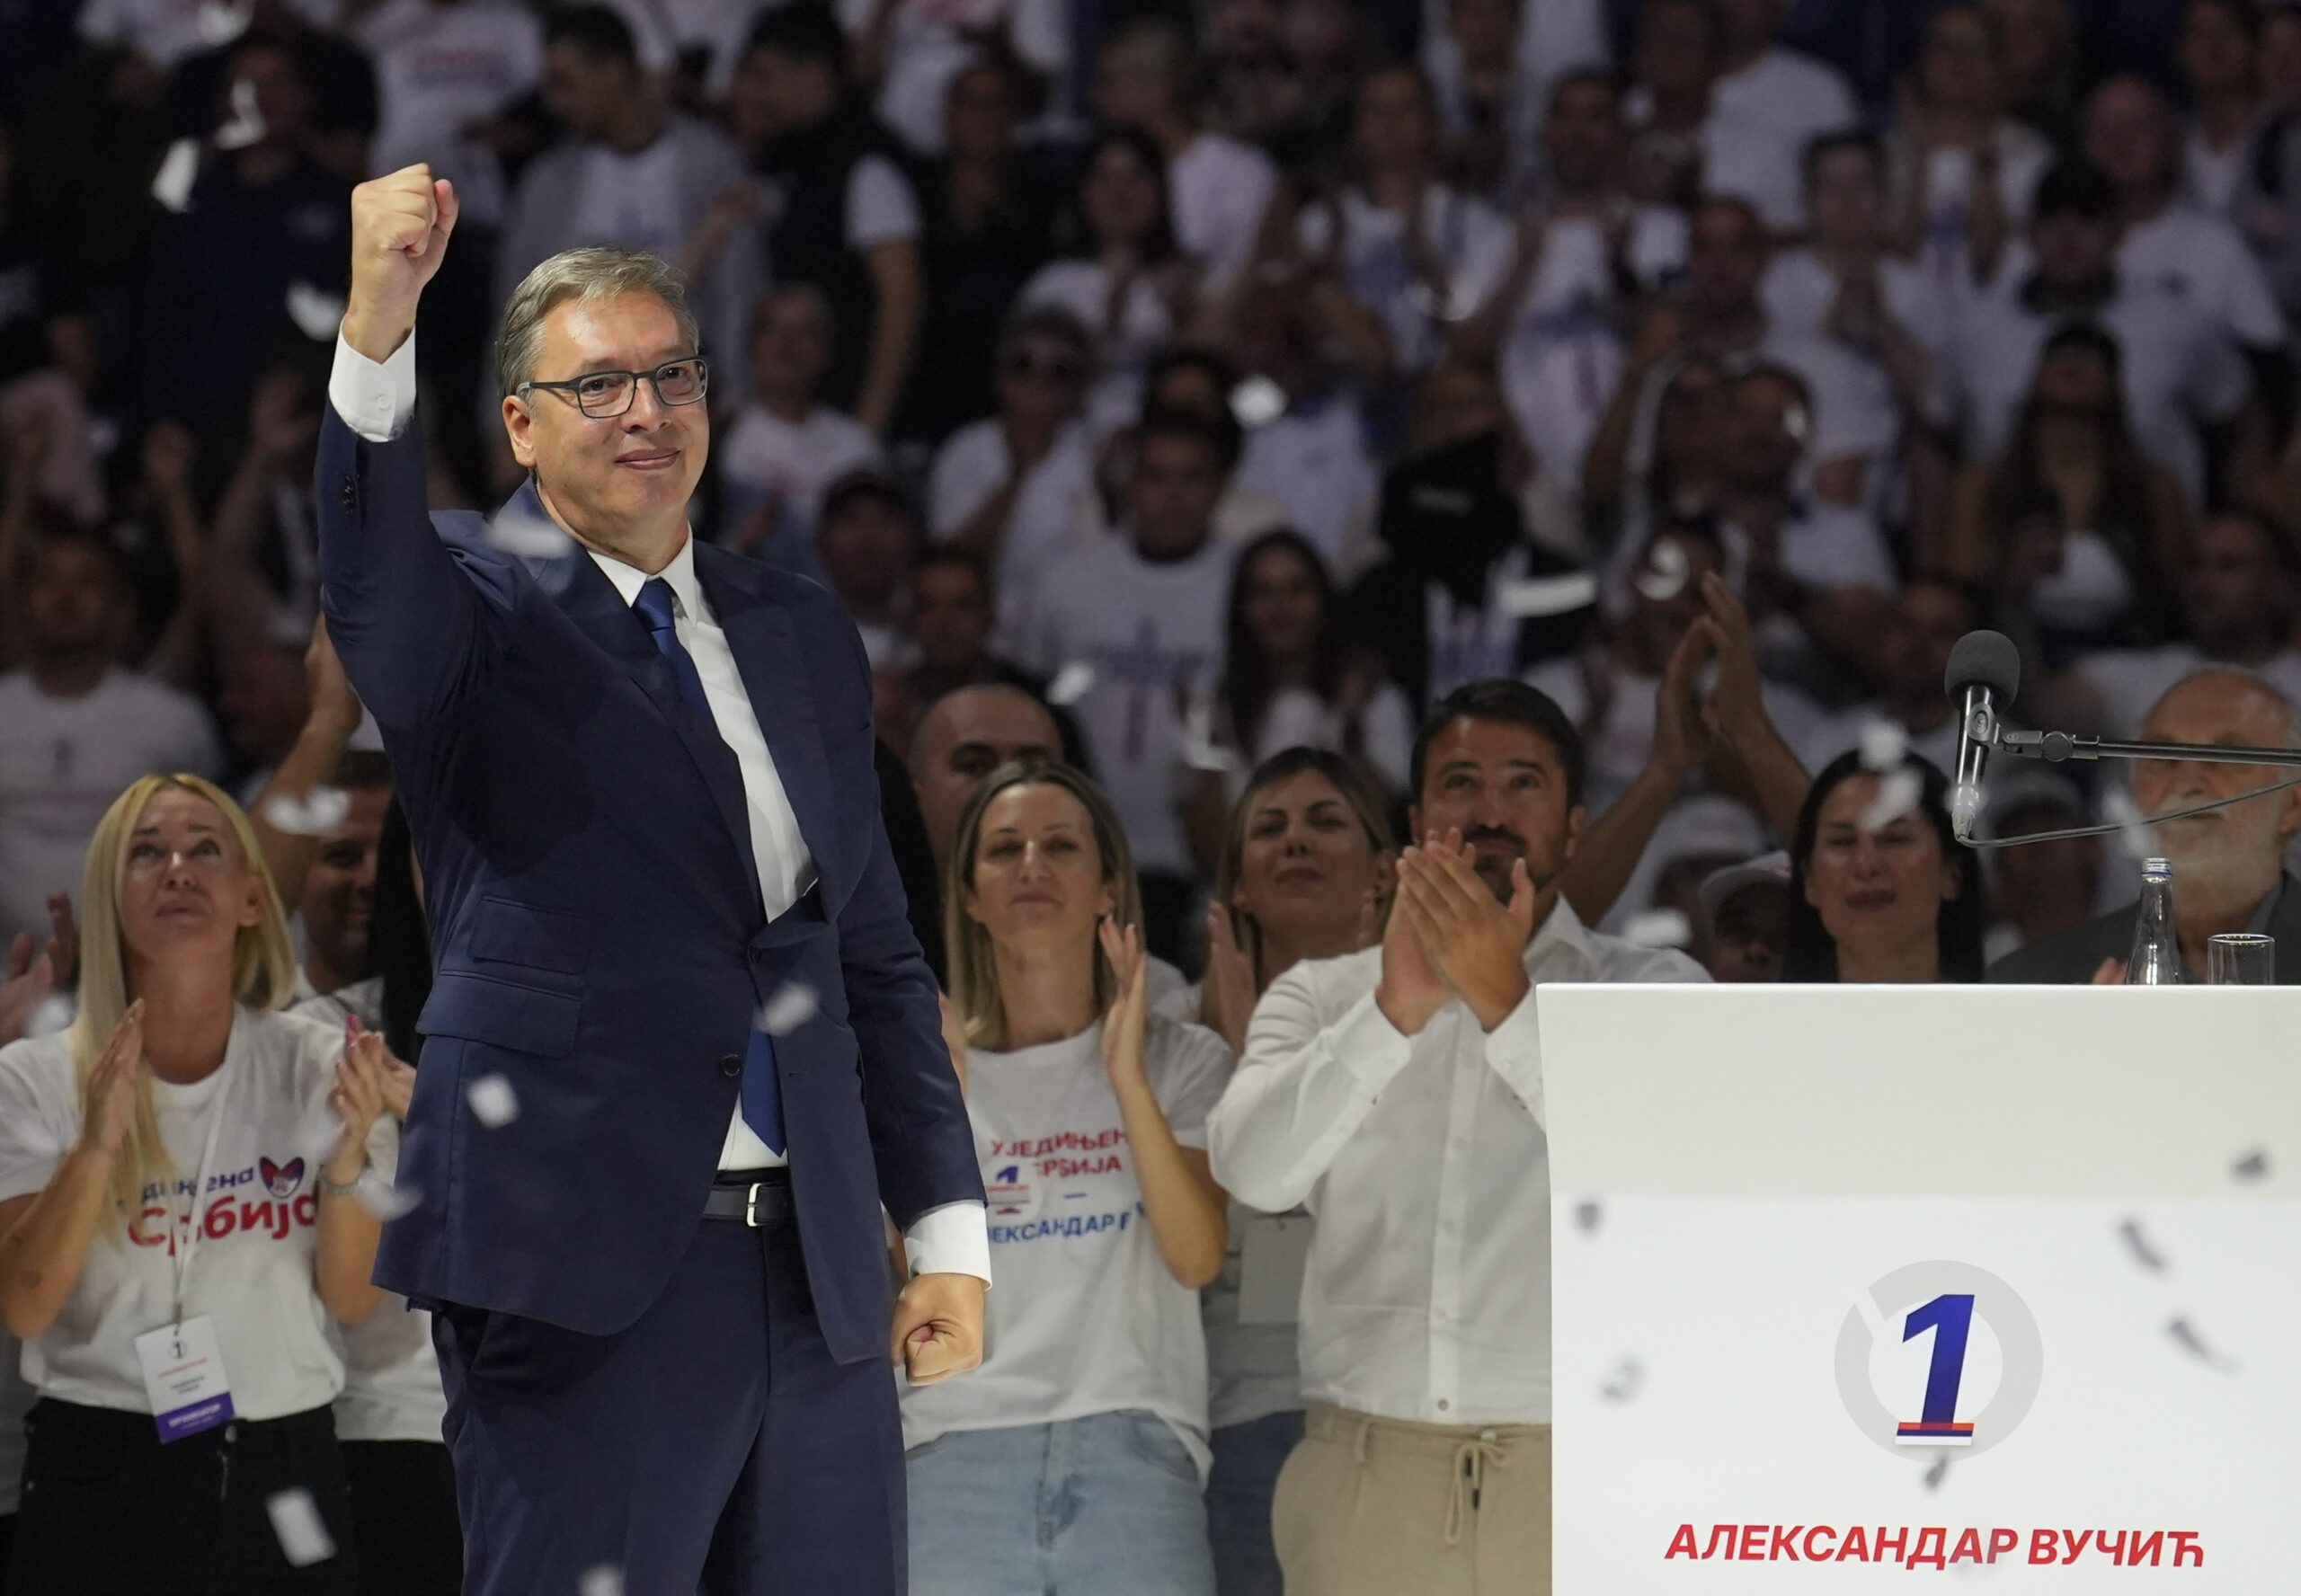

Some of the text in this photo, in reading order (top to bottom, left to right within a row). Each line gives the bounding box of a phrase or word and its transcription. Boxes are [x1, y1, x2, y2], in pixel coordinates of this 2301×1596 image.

[991, 1128, 1127, 1158] УЈЕДИЊЕН
[1896, 1294, 1976, 1441] 1
[1665, 1524, 2204, 1571] АЛЕКСАНДАР ВУЧИЋ
